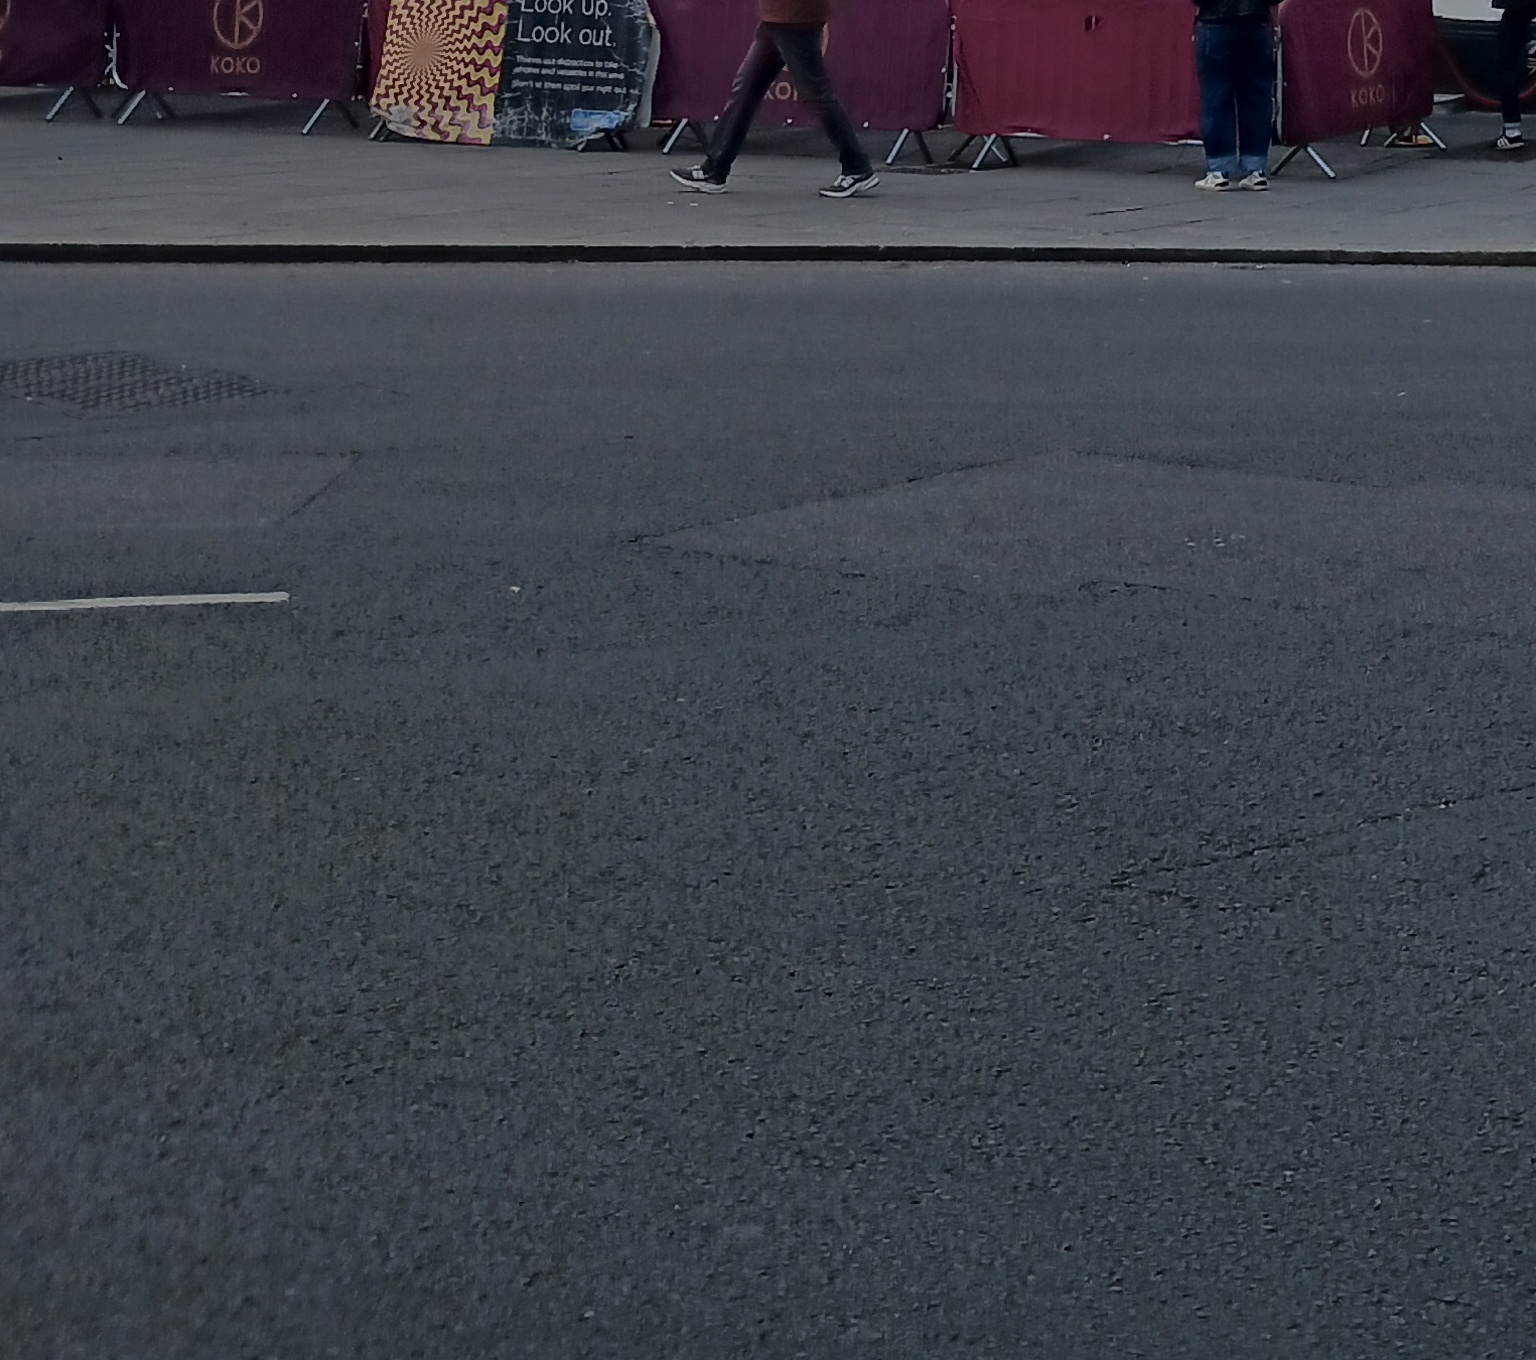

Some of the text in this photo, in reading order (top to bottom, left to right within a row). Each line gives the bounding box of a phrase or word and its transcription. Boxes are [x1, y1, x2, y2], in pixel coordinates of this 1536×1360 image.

[517, 15, 617, 47] Look out.
[210, 55, 261, 74] KOKO
[1350, 84, 1385, 108] KOKO
